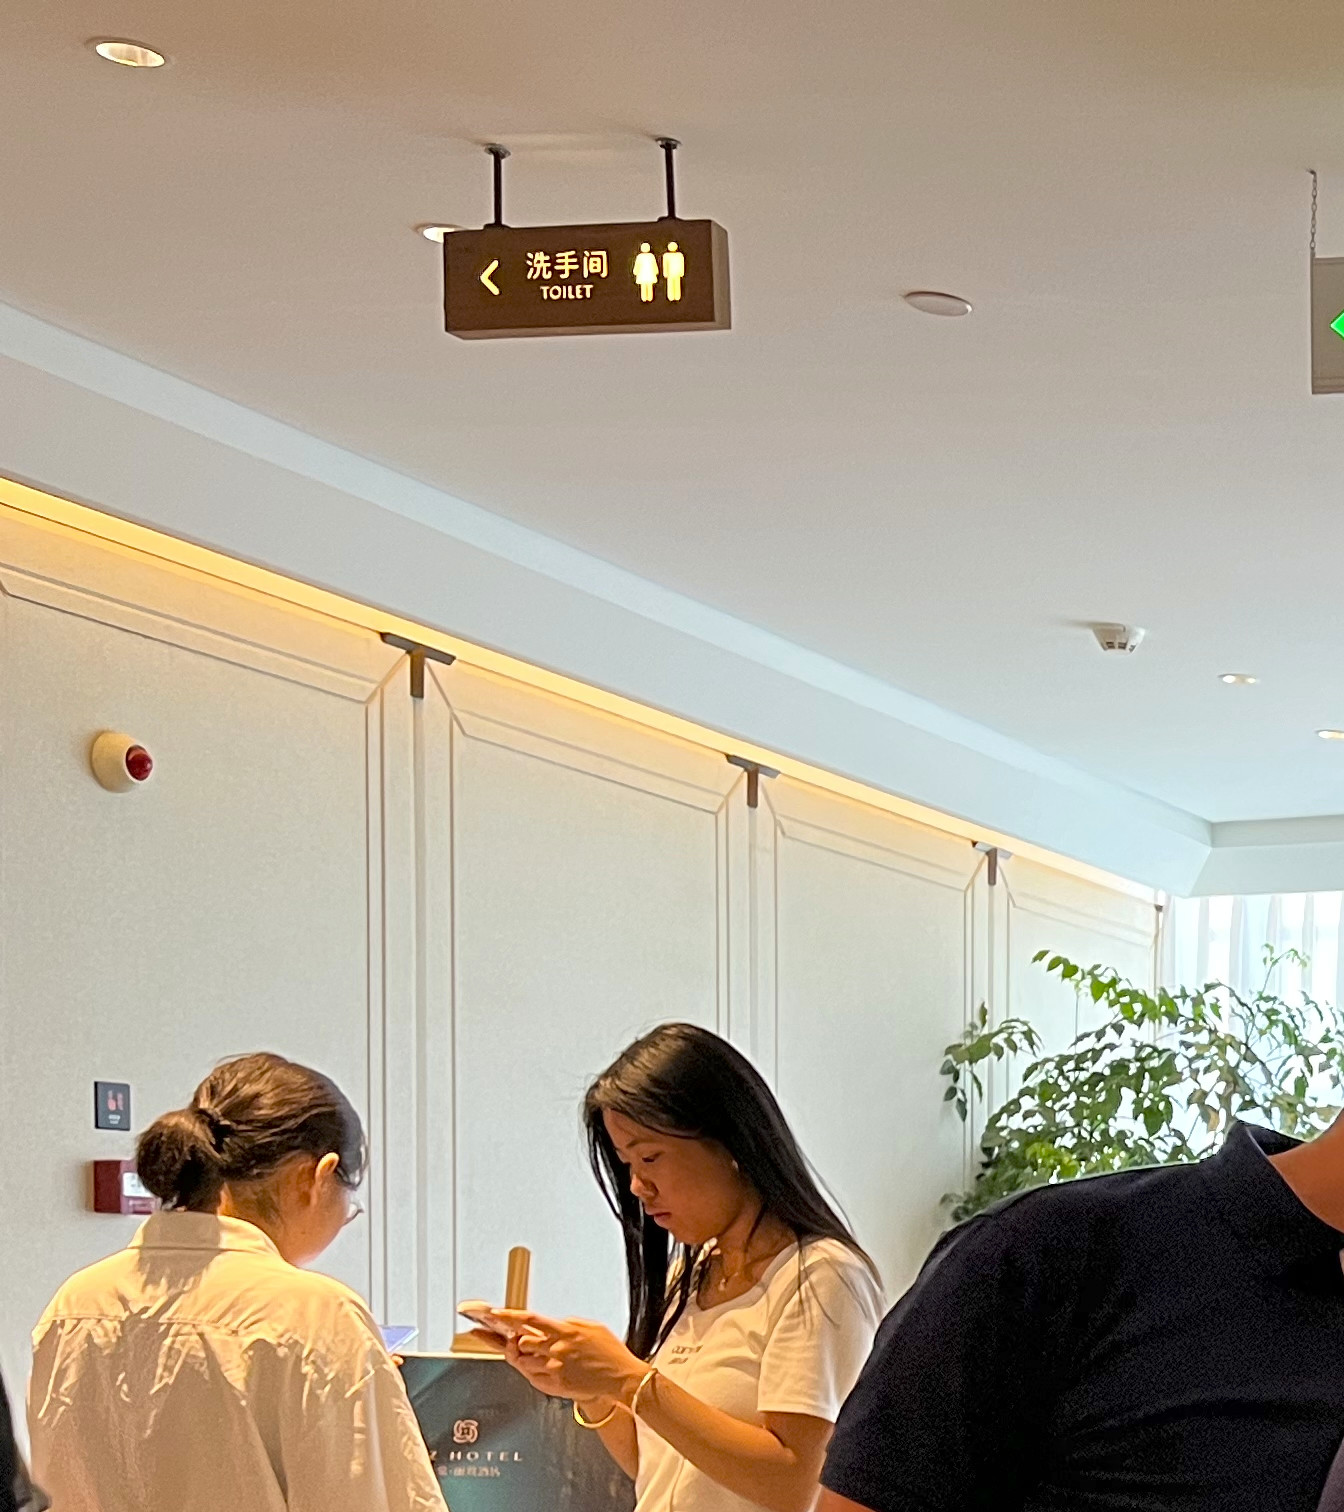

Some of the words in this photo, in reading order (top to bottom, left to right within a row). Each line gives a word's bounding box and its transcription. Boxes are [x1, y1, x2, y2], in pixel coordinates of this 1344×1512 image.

[526, 250, 609, 279] 洗手间
[540, 284, 594, 300] TOILET
